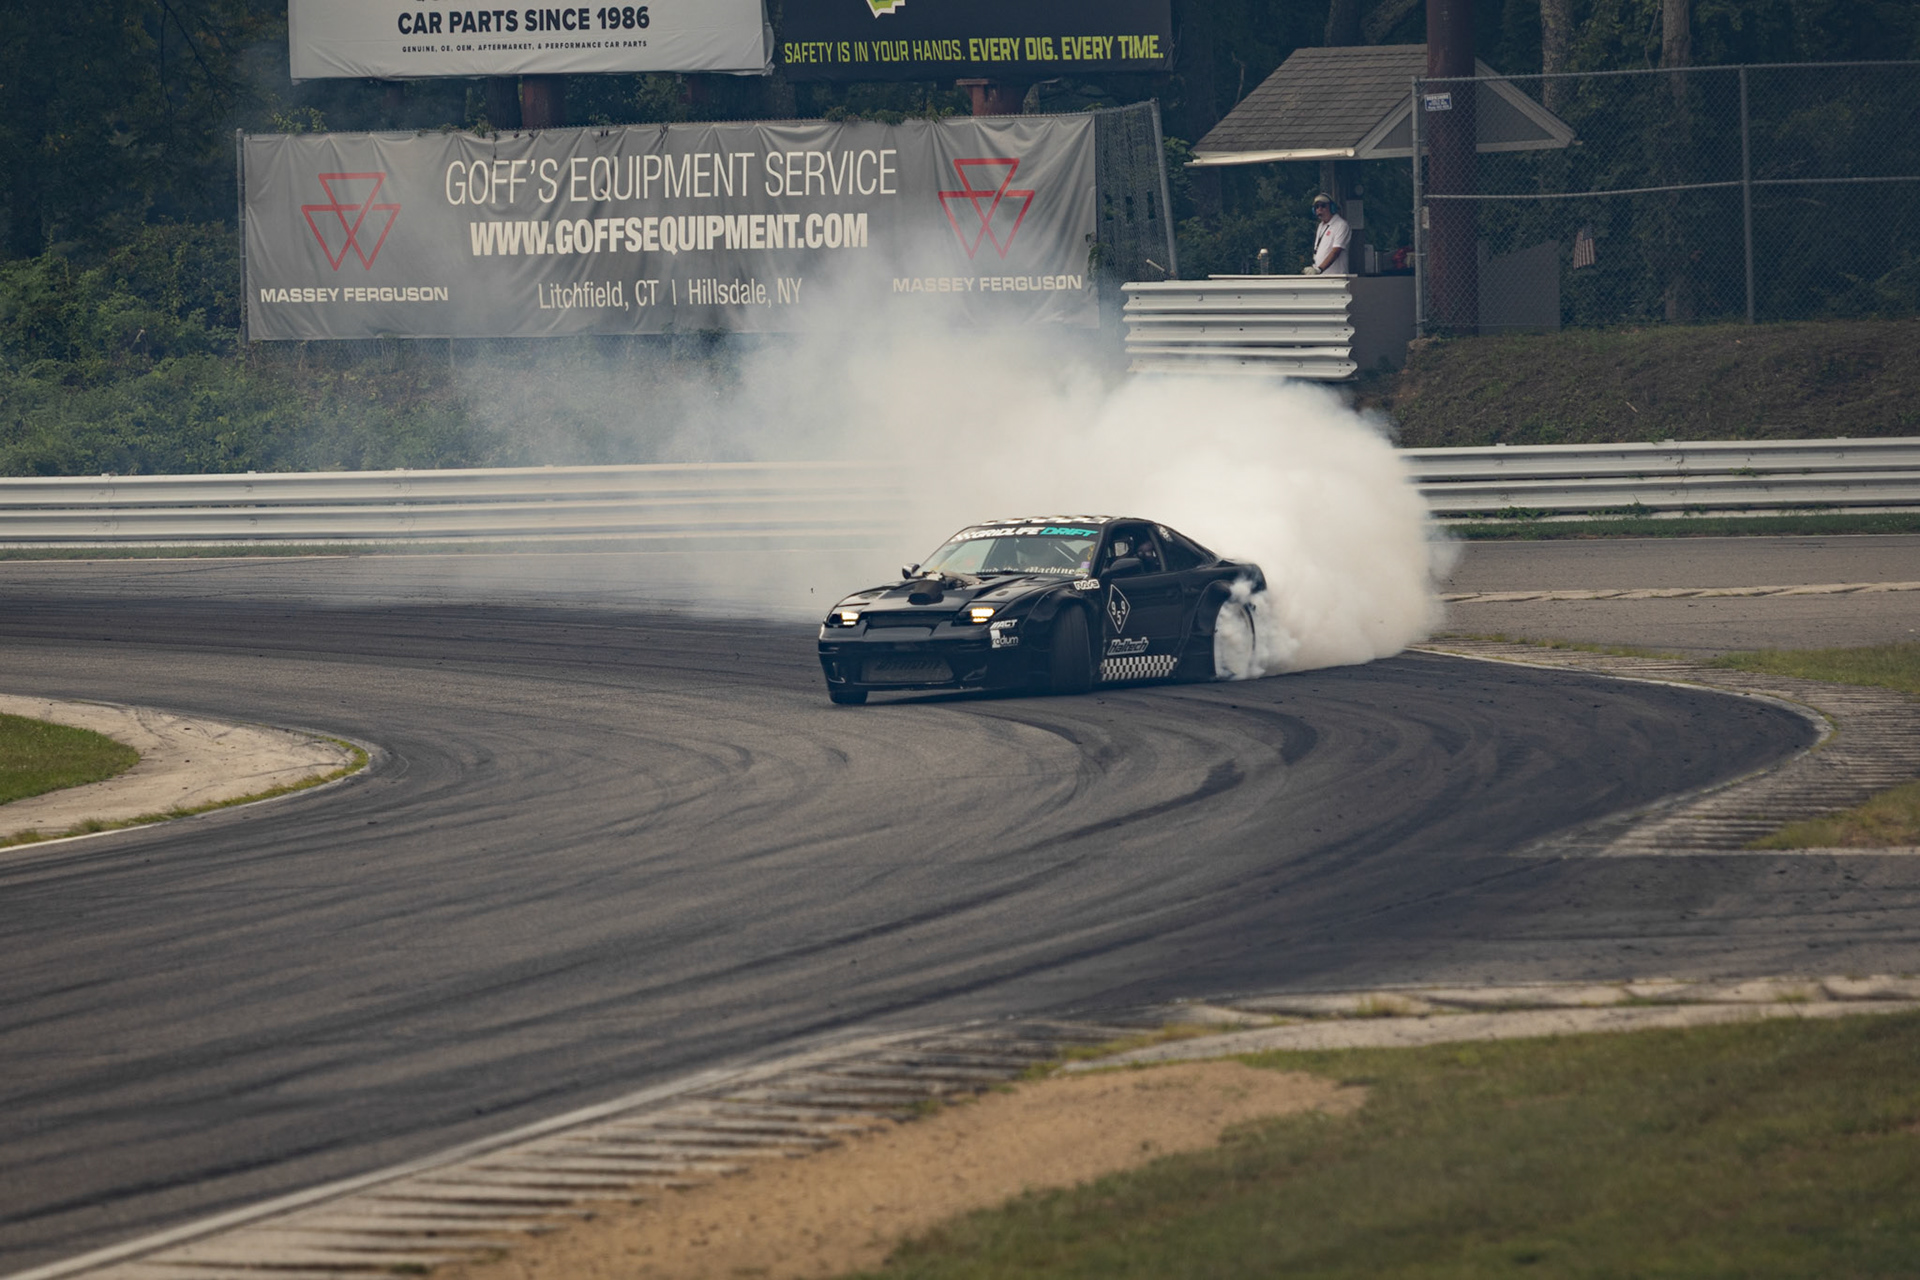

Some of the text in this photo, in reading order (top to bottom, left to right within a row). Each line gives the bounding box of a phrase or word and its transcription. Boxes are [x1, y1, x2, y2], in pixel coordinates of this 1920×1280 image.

[397, 6, 650, 35] CAR PARTS SINCE 1986
[401, 45, 438, 53] GENUINE,
[440, 44, 454, 53] OE,
[456, 44, 475, 52] OEM,
[477, 42, 535, 52] AFTERMARKET,
[544, 41, 601, 50] PERFORMANCE
[604, 40, 620, 49] CAR
[622, 40, 647, 48] PARTS
[784, 34, 1164, 64] SAFETY IS IN YOUR HANDS. EVERY DIG. EVERY TIME.
[445, 148, 897, 206] GOFF'S EQUIPMENT SERVICE
[469, 212, 869, 257] WWW.GOFFSEQUIPMENT.COM
[260, 286, 449, 303] MASSEY FERGUSON
[537, 280, 630, 312] Litchfield,
[634, 279, 660, 307] CT
[687, 277, 773, 308] Hillsdale,
[776, 276, 802, 305] NY
[892, 274, 1082, 293] MASSEY FERGUSON
[971, 526, 1098, 539] GRIDLIFE DRIFT
[1107, 636, 1150, 656] Haltech
